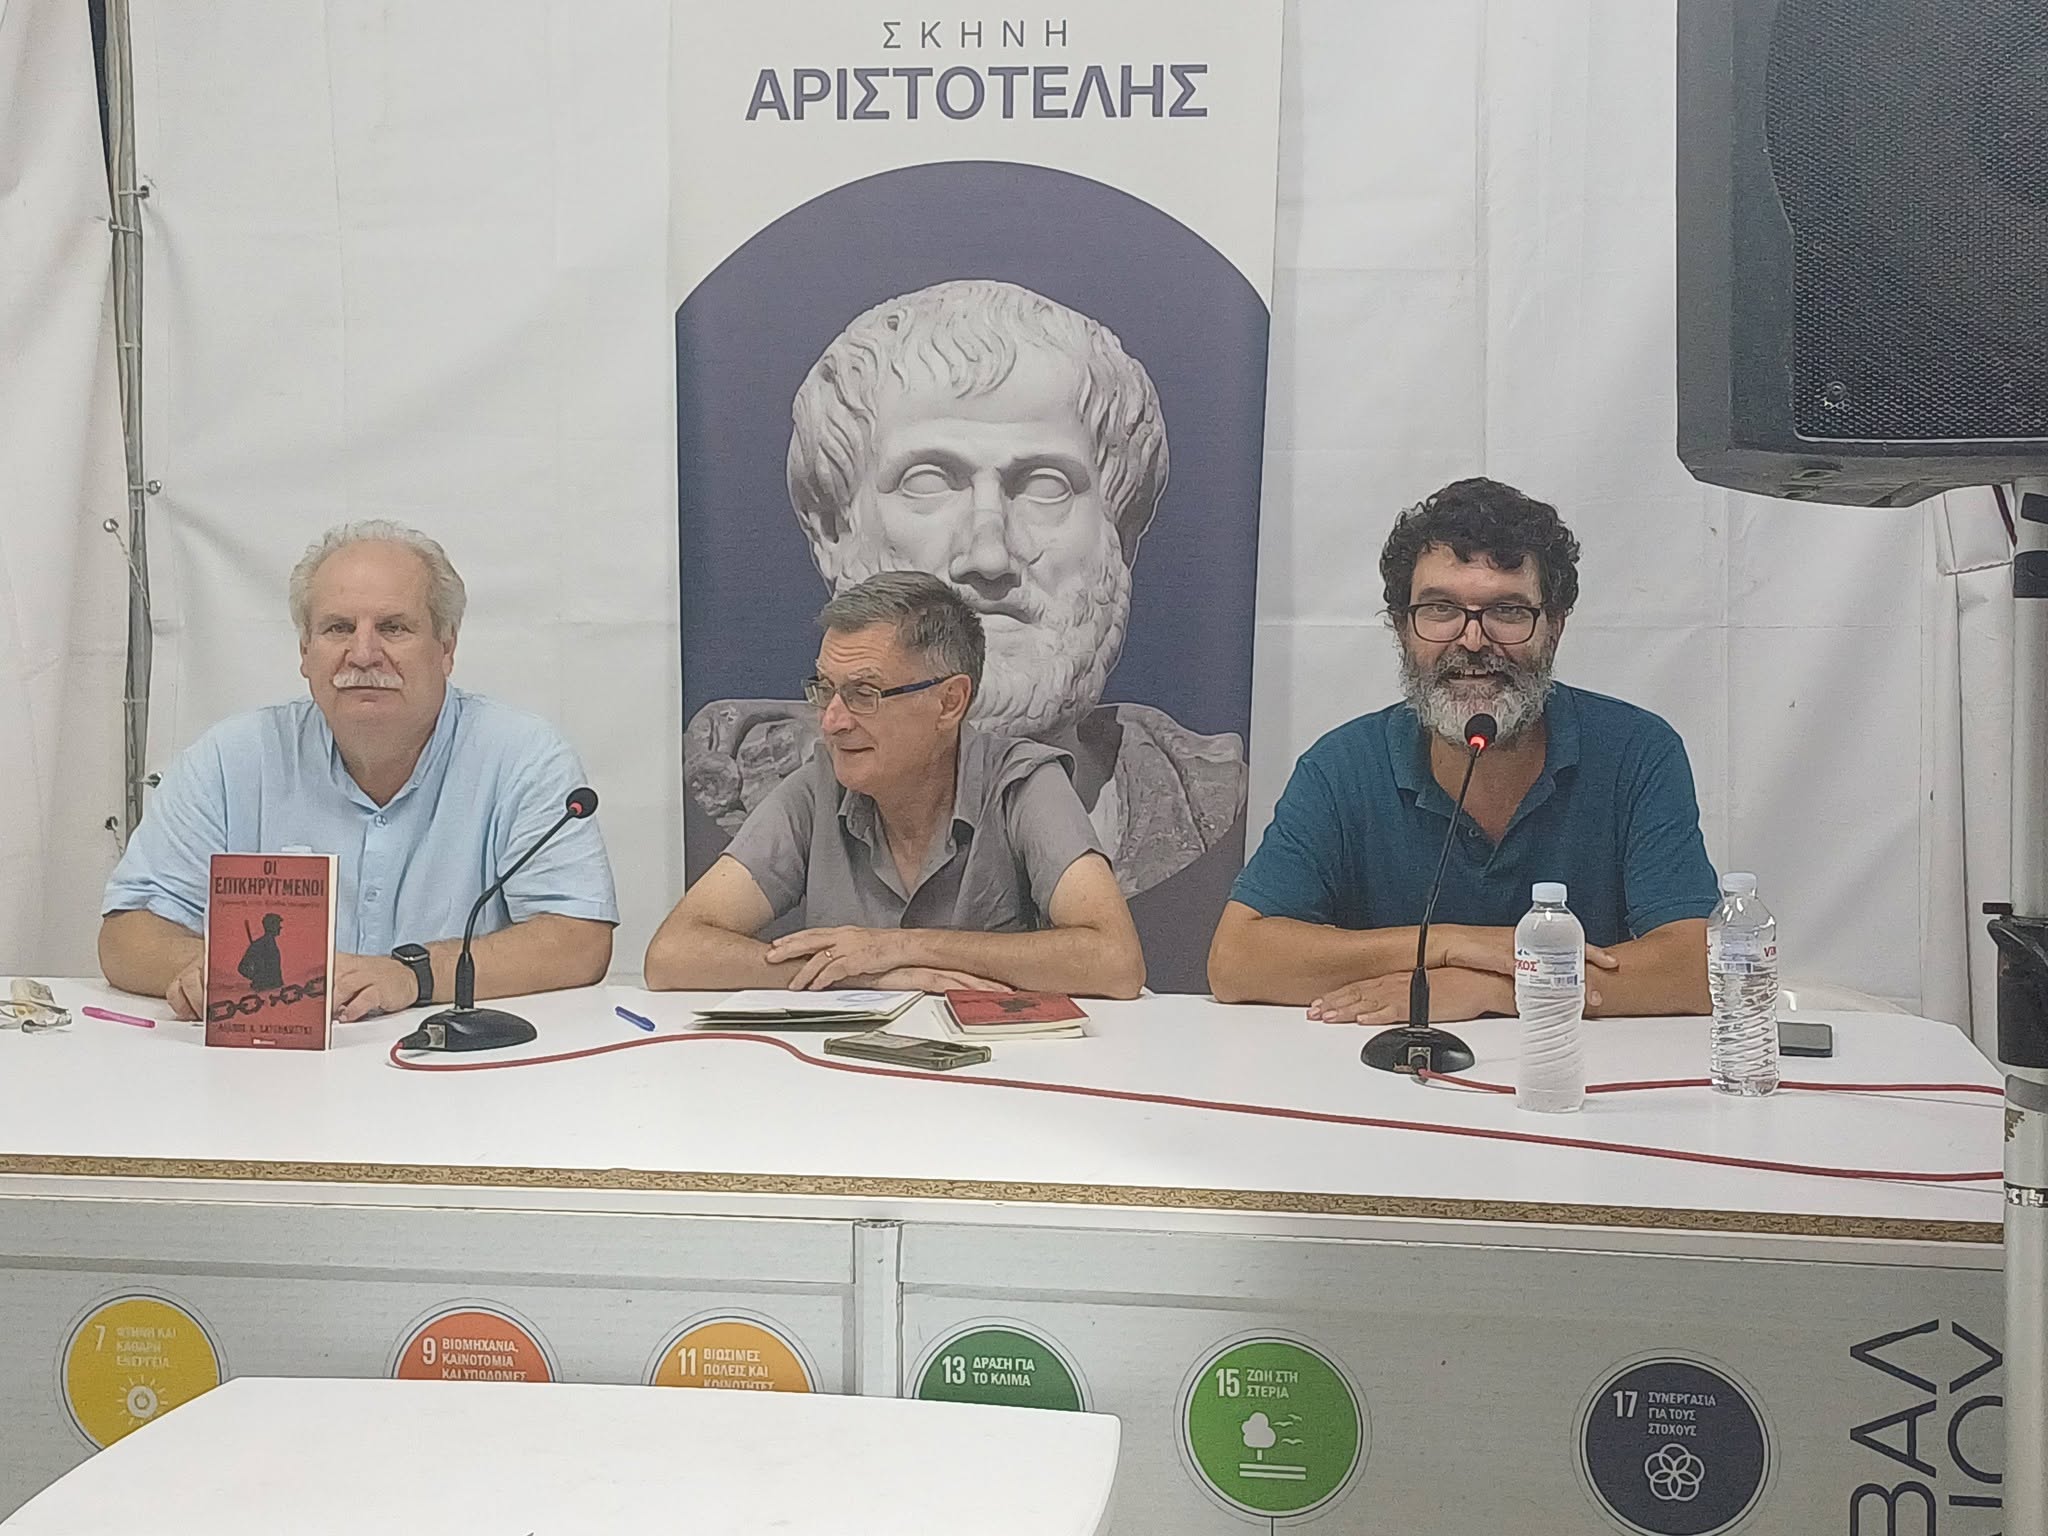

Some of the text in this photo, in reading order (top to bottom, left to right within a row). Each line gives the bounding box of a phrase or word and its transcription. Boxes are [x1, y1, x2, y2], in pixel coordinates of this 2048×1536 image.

[883, 20, 1067, 48] ΣΚΗΝΗ
[745, 64, 1208, 121] ΑΡΙΣΤΟΤΕΛΗΣ
[94, 1325, 106, 1351] 7
[422, 1337, 436, 1365] 9
[703, 1348, 761, 1362] ΒΙΩΣΙΜΕΣ
[442, 1352, 514, 1367] ΚΑΙΝΟΤΟΜΙΑ
[678, 1348, 697, 1376] 11
[972, 1356, 1036, 1372] ΔΡΑΣΗ ΓΙΑ
[442, 1367, 461, 1379] ΚΑΙ
[703, 1363, 769, 1378] ΠΟΛΕΙΣ ΚΑΙ
[942, 1355, 966, 1385] 13
[1246, 1369, 1299, 1384] ΖΩΗ ΣΤΗ
[972, 1371, 1032, 1387] ΤΟ ΚΛΙΜΑ
[1215, 1368, 1241, 1398] 15
[1246, 1385, 1290, 1399] ΣΤΕΡΙΑ
[1647, 1391, 1717, 1407] ΣΥΝΕΡΓΑΣΙΑ
[1612, 1390, 1639, 1418] 17
[1648, 1407, 1697, 1421] ΓΙΑ ΤΟΥΣ
[1647, 1423, 1697, 1437] ΣΤΟΧΟΥΣ
